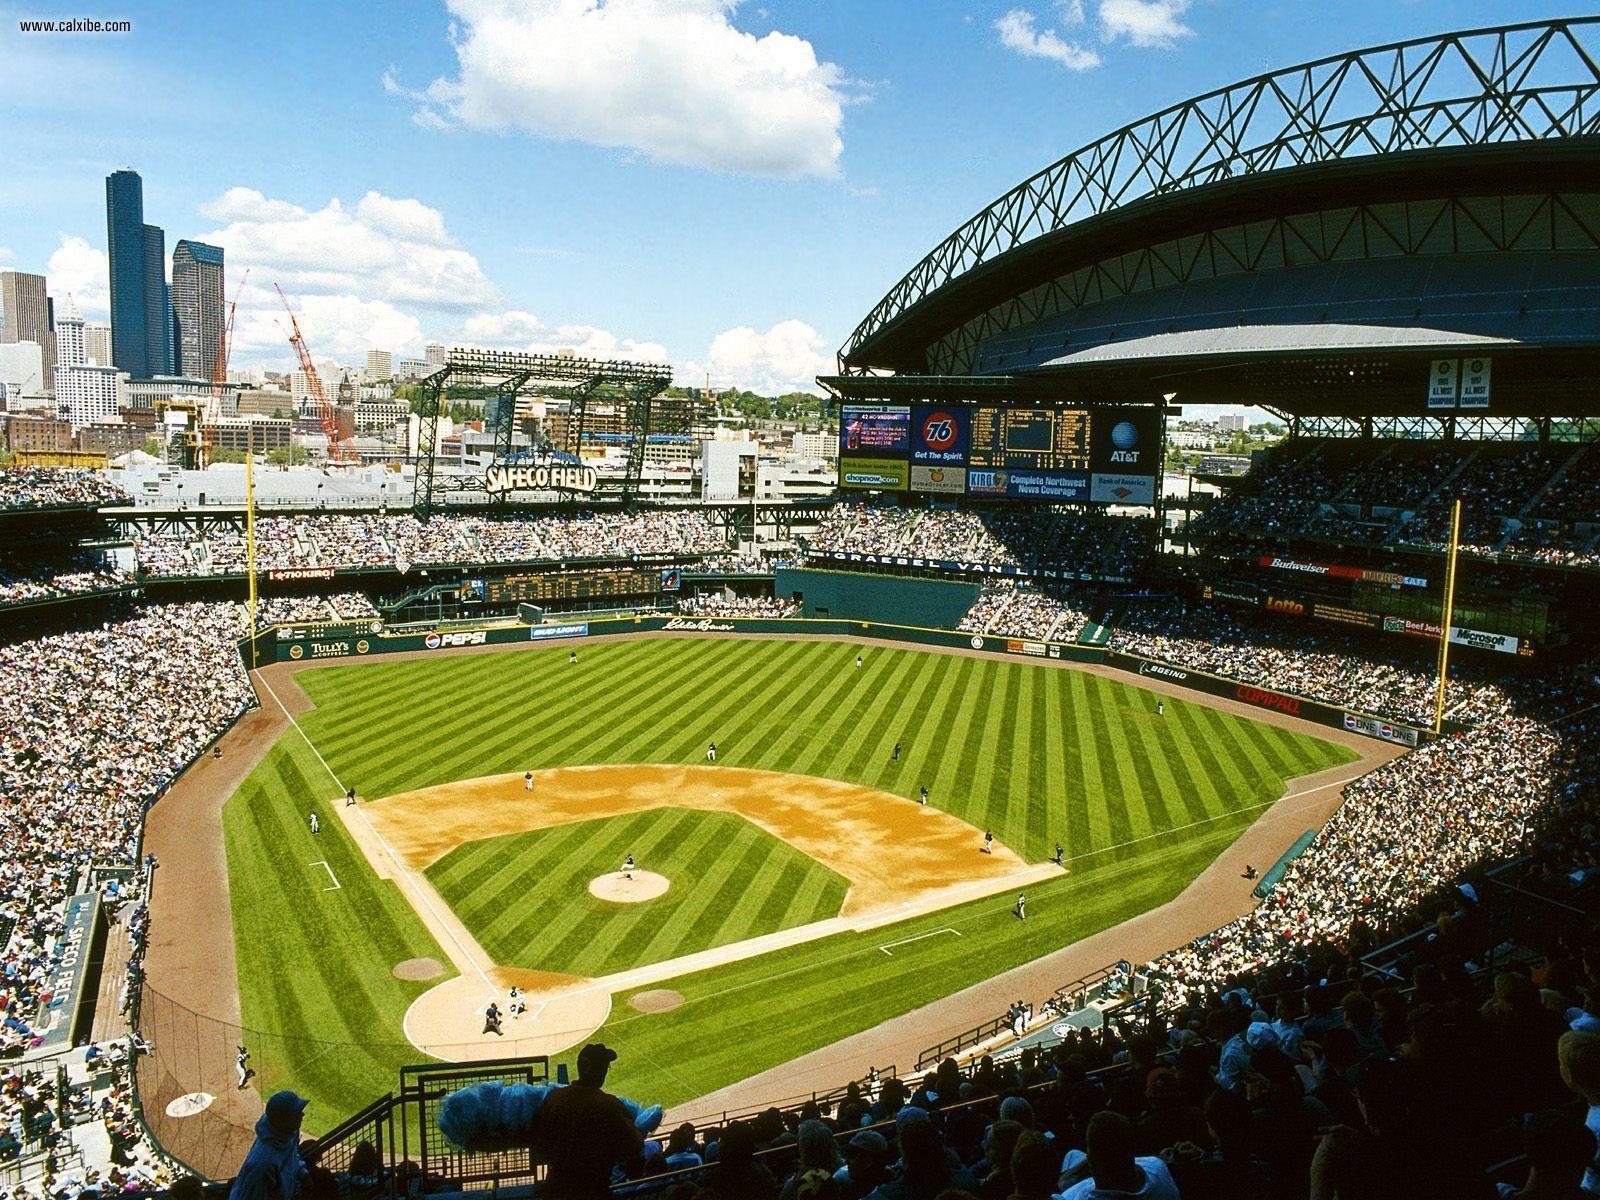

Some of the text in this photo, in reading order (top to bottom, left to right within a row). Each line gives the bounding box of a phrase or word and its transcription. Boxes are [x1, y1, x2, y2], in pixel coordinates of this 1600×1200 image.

[926, 419, 953, 442] 76
[914, 451, 927, 459] Get
[943, 452, 964, 461] Spirit.
[1110, 451, 1140, 463] AT&T
[1058, 460, 1064, 468] 2
[487, 466, 596, 493] SAFECO FIELD
[846, 473, 899, 485] shopnow.com
[1010, 475, 1086, 487] Complete Northwest
[1018, 485, 1039, 494] News
[1041, 485, 1077, 497] Coverage
[834, 552, 940, 568] GRAEBEL
[957, 562, 1002, 573] VAN
[1015, 567, 1093, 581] LINES
[1271, 558, 1330, 575] Budweiser
[1267, 596, 1303, 613] Lotto
[533, 625, 585, 636] BUD LIGHT
[662, 617, 735, 631] Eddie Bauer
[1405, 620, 1424, 631] Beef
[1424, 624, 1445, 636] Jerky
[441, 631, 487, 647] PEPSI
[1457, 628, 1506, 646] Microsoft
[311, 642, 349, 653] TULLY'S
[1150, 665, 1187, 680] BOEING
[1237, 685, 1300, 714] COMPAQ
[1356, 720, 1376, 732] ONE
[1392, 730, 1413, 743] ONE
[61, 926, 84, 968] SAFECO
